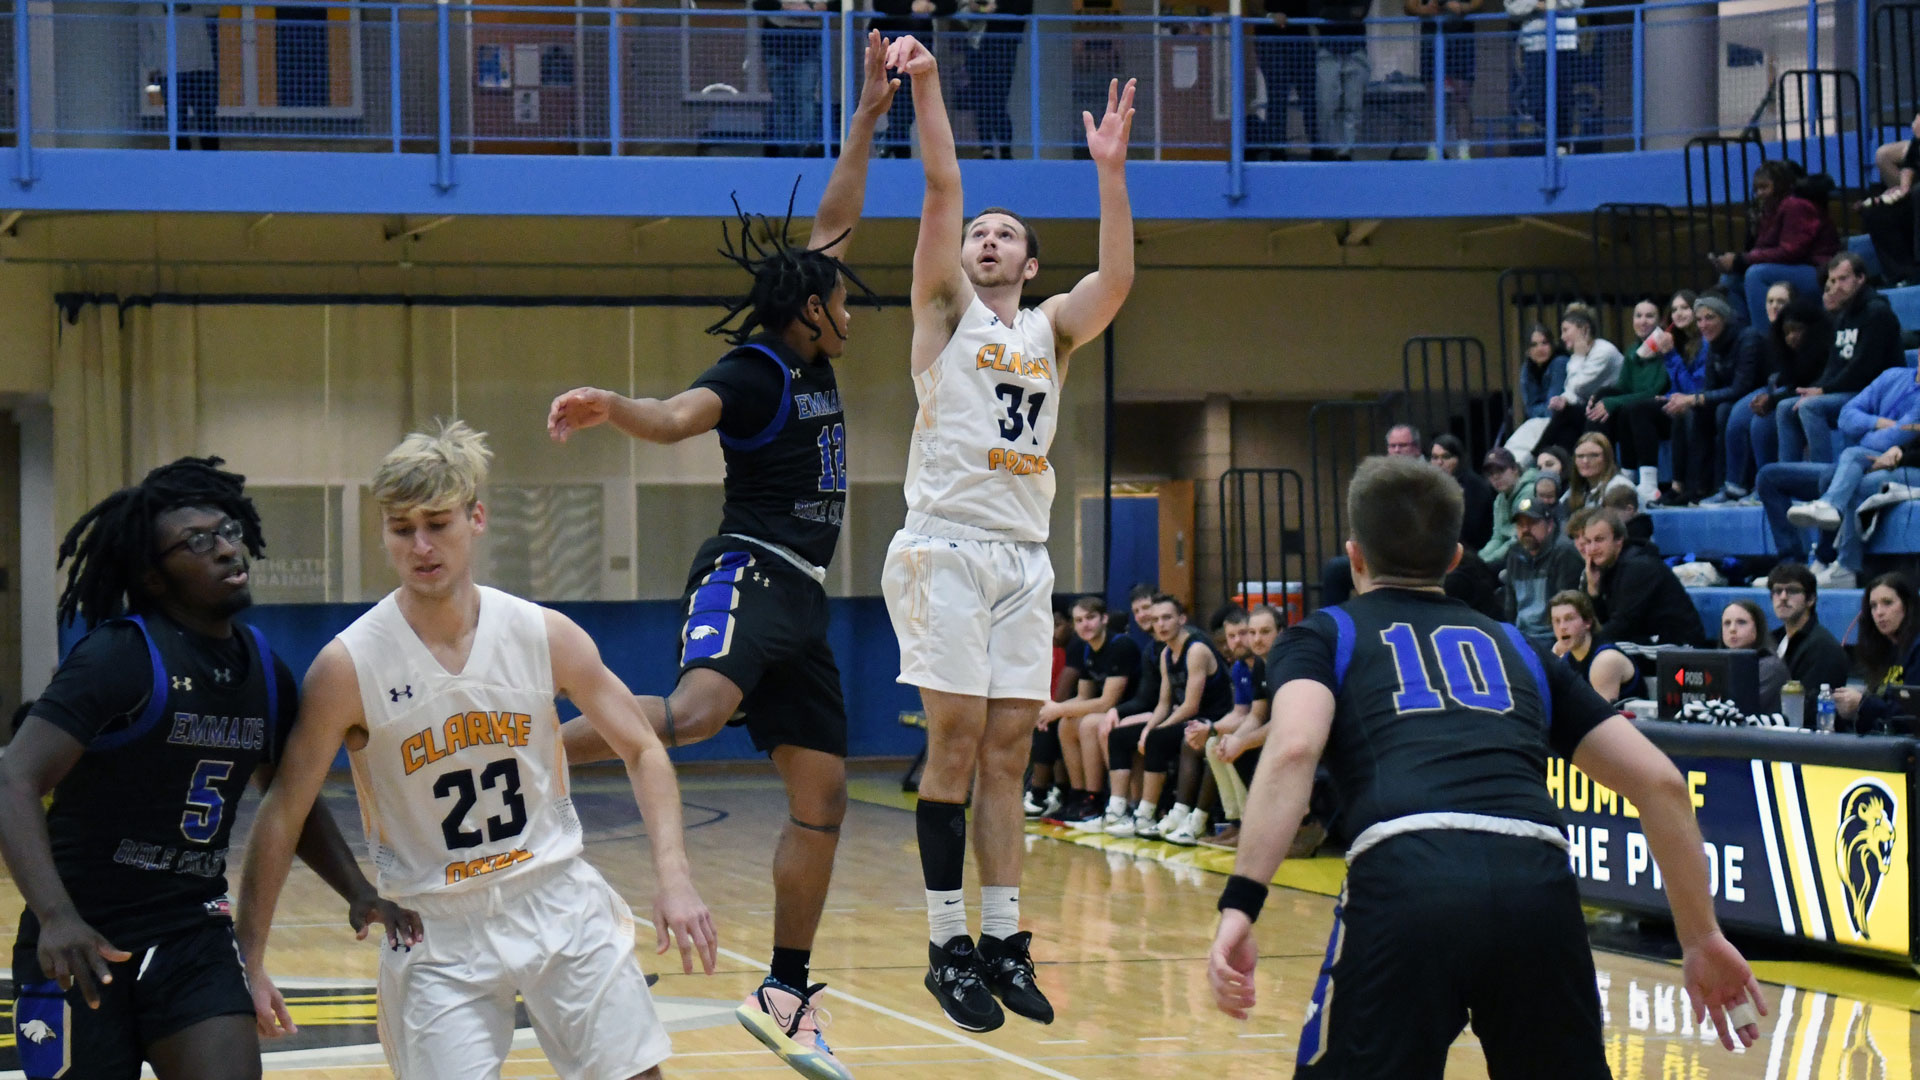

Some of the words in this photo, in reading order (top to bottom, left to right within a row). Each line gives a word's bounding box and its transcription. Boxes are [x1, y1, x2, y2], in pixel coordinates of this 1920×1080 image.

[995, 382, 1046, 445] 31
[817, 422, 846, 492] 12
[1379, 622, 1515, 715] 10
[167, 711, 265, 750] EMMAUS
[400, 710, 532, 776] CLARKE
[180, 759, 235, 844] 5
[432, 757, 527, 851] 23
[1567, 823, 1611, 882] HE
